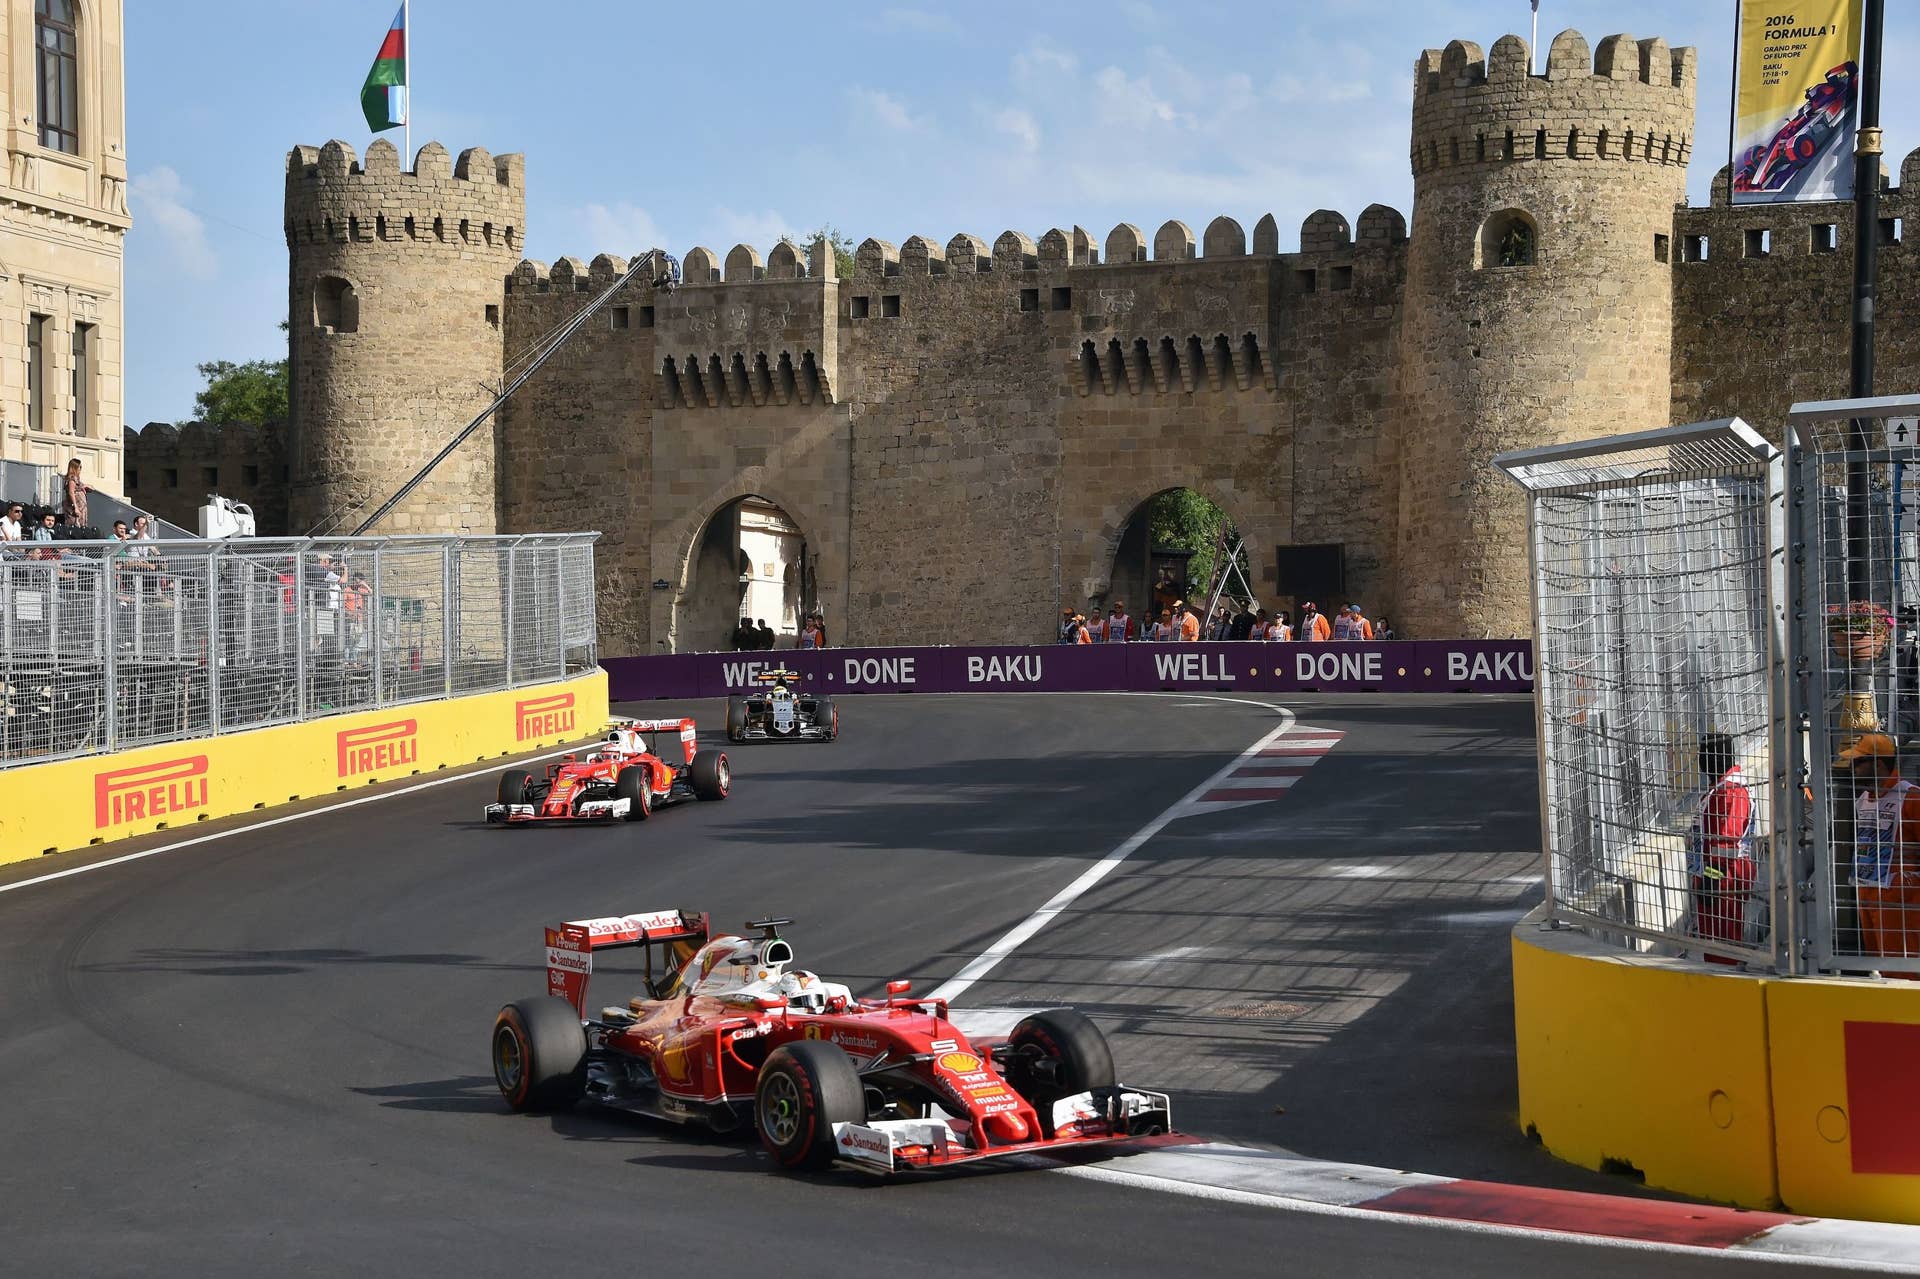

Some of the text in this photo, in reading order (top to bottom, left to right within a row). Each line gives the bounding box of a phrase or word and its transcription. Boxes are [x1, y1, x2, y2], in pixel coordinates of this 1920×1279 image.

[1765, 15, 1795, 27] 2016
[1764, 25, 1836, 40] FORMULA 1
[1763, 45, 1790, 53] GRAND
[1774, 51, 1801, 59] EUROPE
[844, 657, 915, 684] DONE
[967, 655, 1042, 682] BAKU
[1154, 653, 1236, 681] WELL
[1296, 652, 1383, 681] DONE
[1447, 652, 1535, 681] BAKU
[516, 692, 575, 741] PIRELLI
[337, 719, 418, 777] PIRELLI
[95, 755, 208, 829] PIRELLI
[556, 952, 587, 971] Santander
[839, 1031, 878, 1049] Santander
[930, 1039, 959, 1054] 5
[974, 1094, 1014, 1105] MAHLE
[985, 1101, 1018, 1113] telcel
[853, 1134, 889, 1154] Santander
